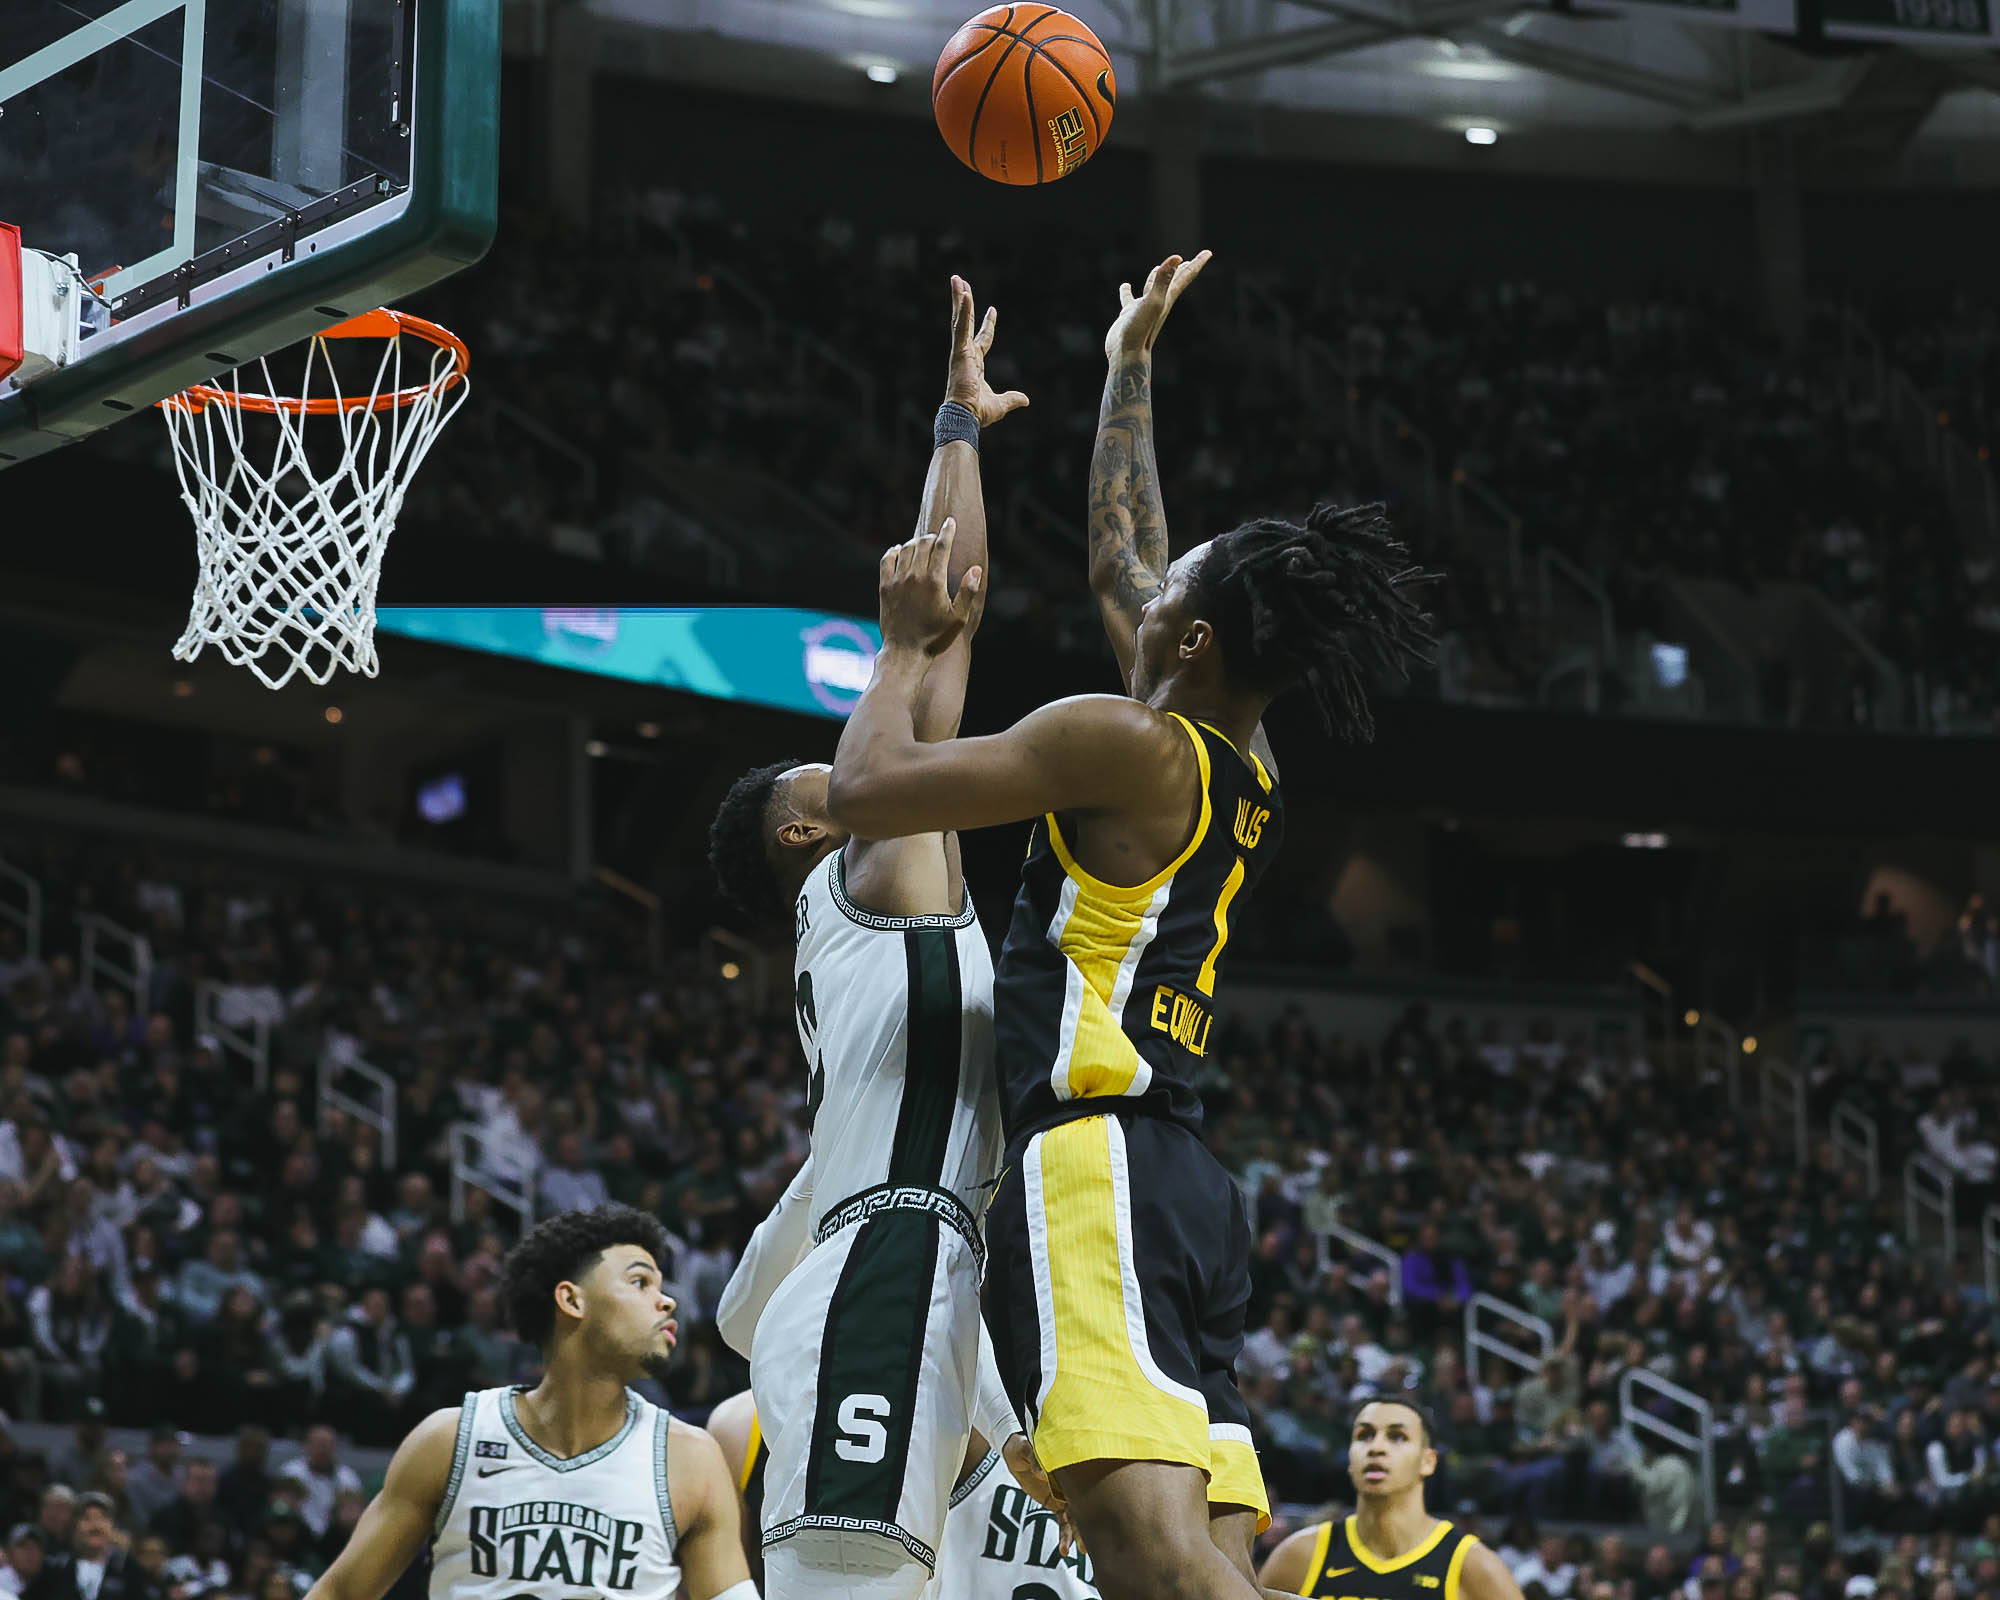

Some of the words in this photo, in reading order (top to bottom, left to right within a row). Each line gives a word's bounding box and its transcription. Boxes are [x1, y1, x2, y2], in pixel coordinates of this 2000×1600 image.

[1233, 796, 1271, 850] ULIS
[1195, 856, 1245, 999] 1
[834, 1393, 891, 1464] S
[469, 1505, 644, 1590] STATE
[503, 1502, 612, 1537] MICHIGAN
